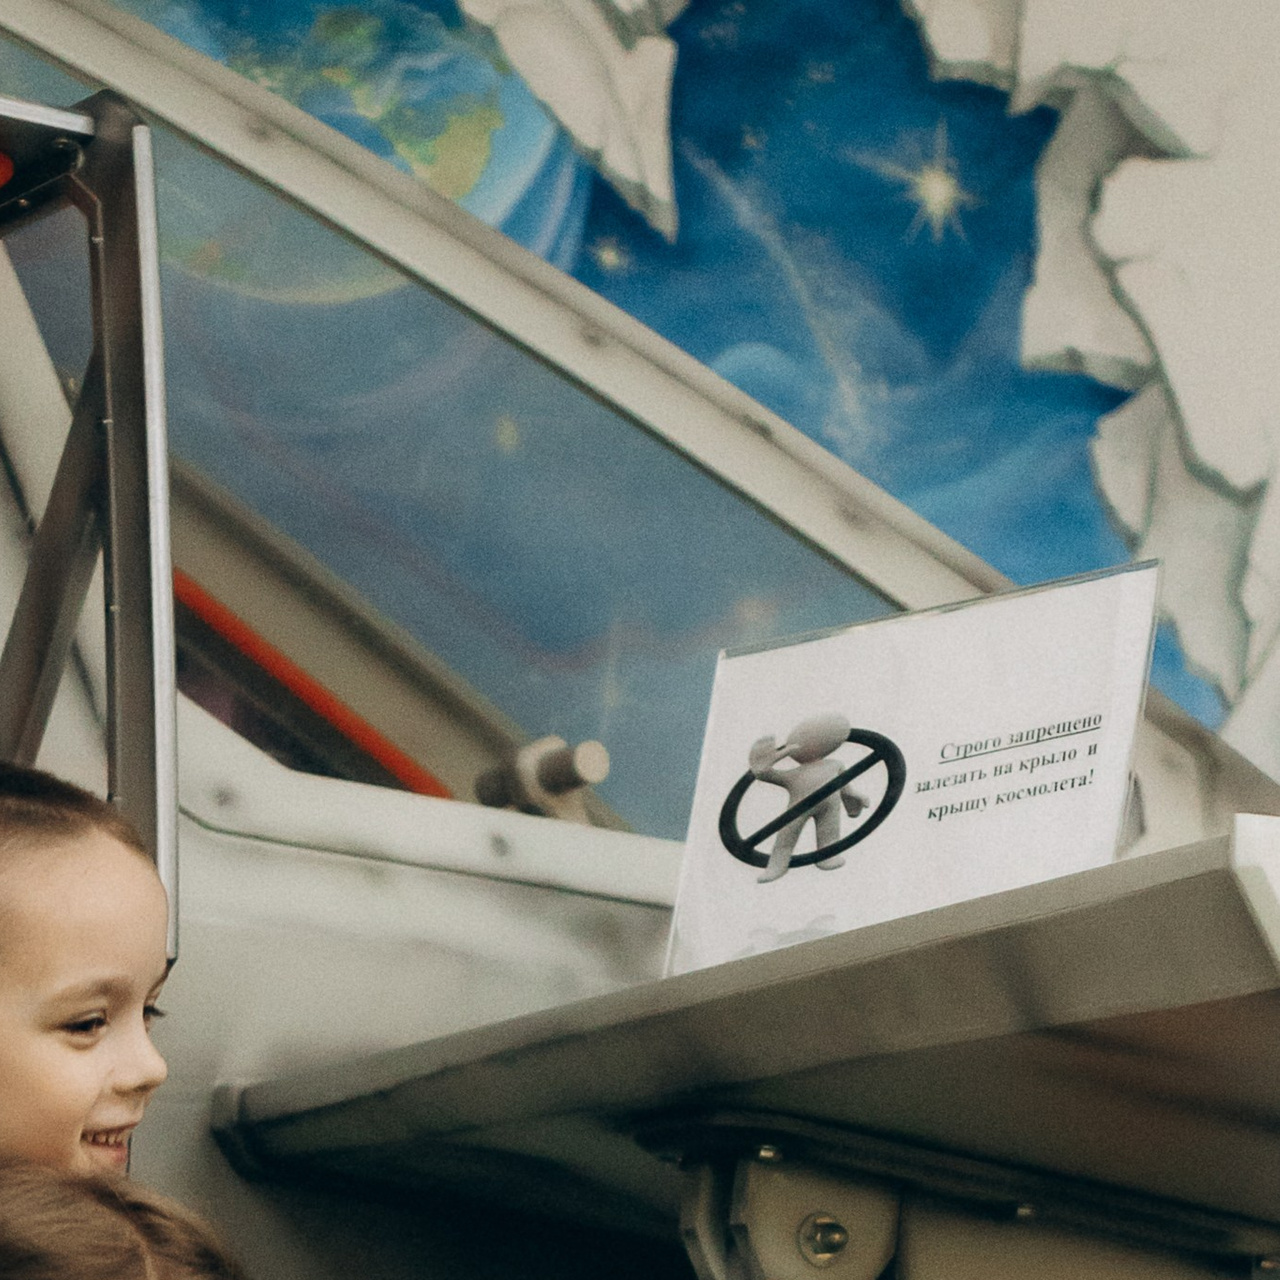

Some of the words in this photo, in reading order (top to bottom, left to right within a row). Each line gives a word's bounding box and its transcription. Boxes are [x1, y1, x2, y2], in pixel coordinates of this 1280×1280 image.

[940, 737, 1001, 761] Строго
[1008, 714, 1102, 743] запрещено
[915, 770, 987, 793] залезать
[993, 762, 1012, 777] на
[1019, 748, 1077, 773] крыло
[1087, 743, 1098, 756] и
[927, 796, 990, 821] крышу
[995, 769, 1094, 806] космолета!
